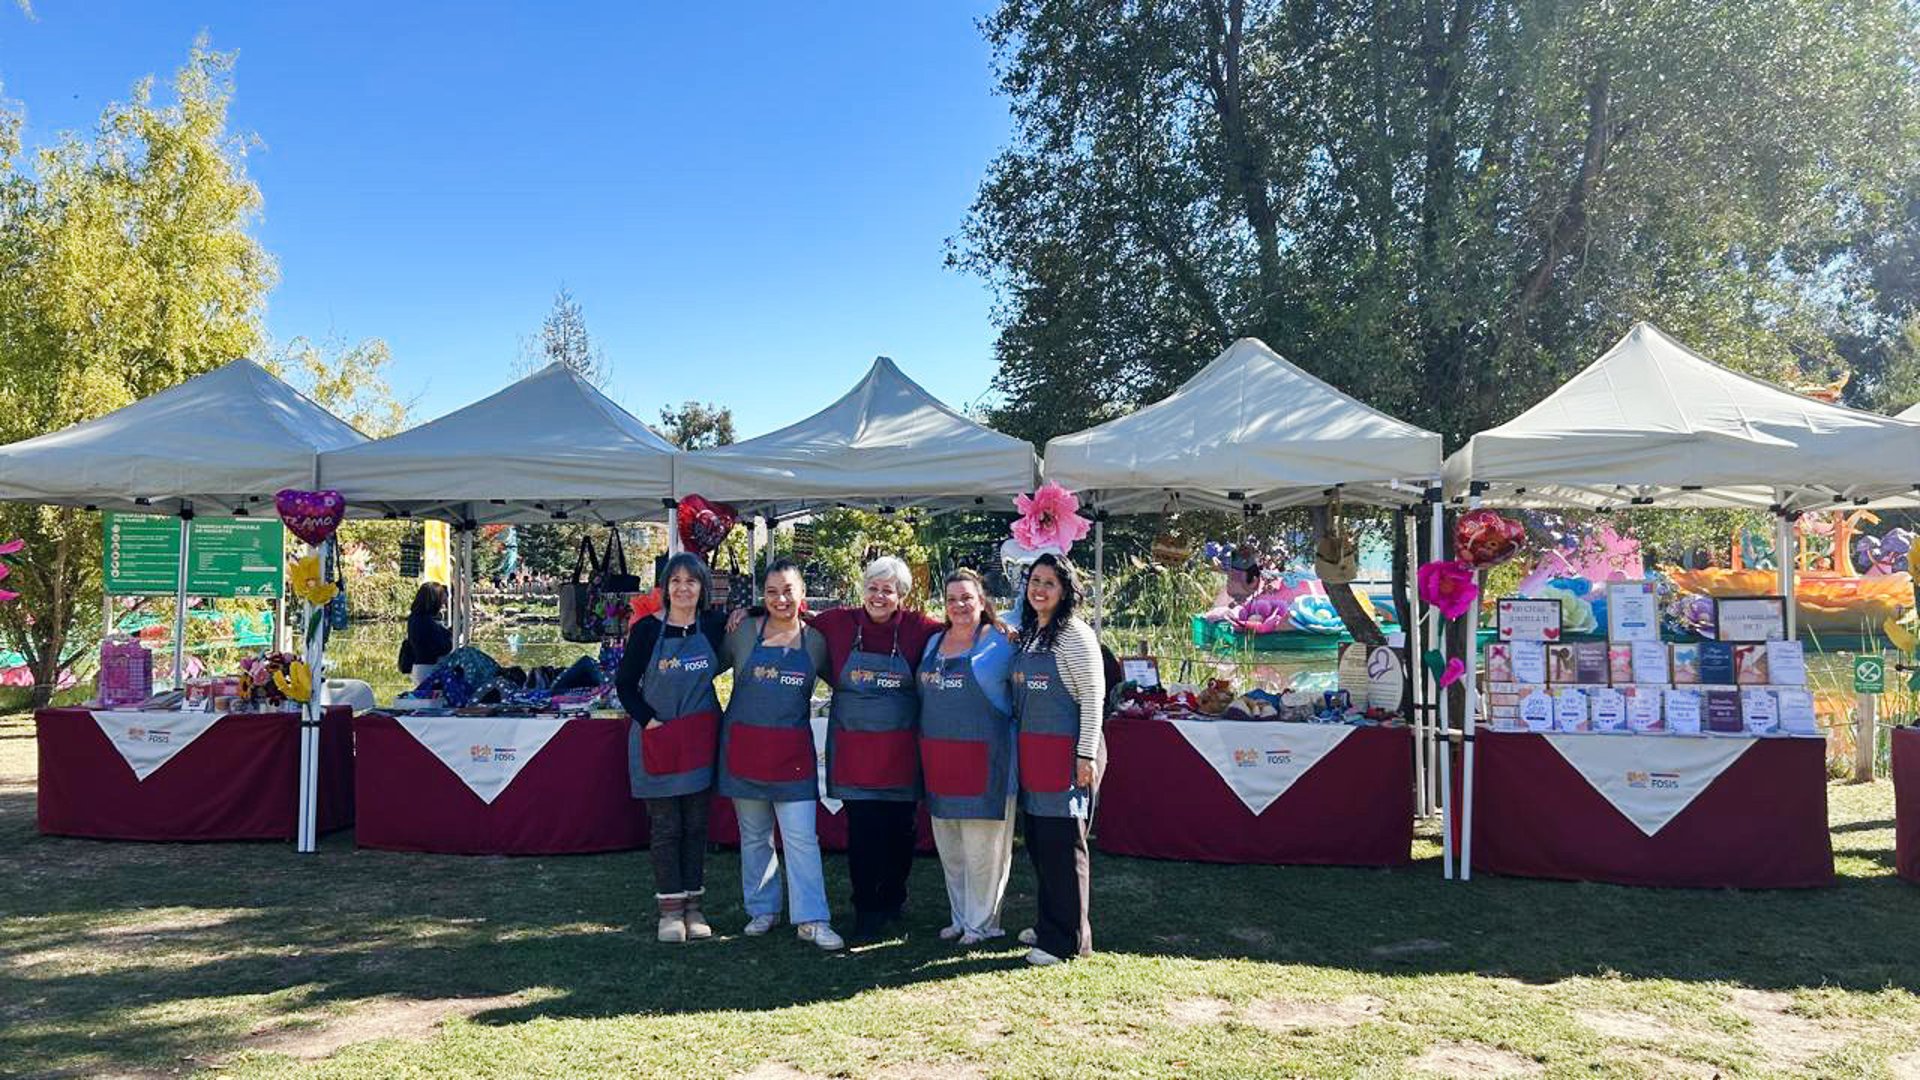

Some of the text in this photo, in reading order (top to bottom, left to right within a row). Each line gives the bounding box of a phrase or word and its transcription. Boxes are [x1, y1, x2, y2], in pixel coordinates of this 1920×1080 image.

[684, 659, 709, 671] FOSIS
[780, 675, 804, 686] FOSIS
[877, 679, 900, 687] FOSIS
[494, 753, 516, 761] FOSIS
[1267, 756, 1291, 764] FOSIS
[1651, 780, 1679, 788] FOSIS
